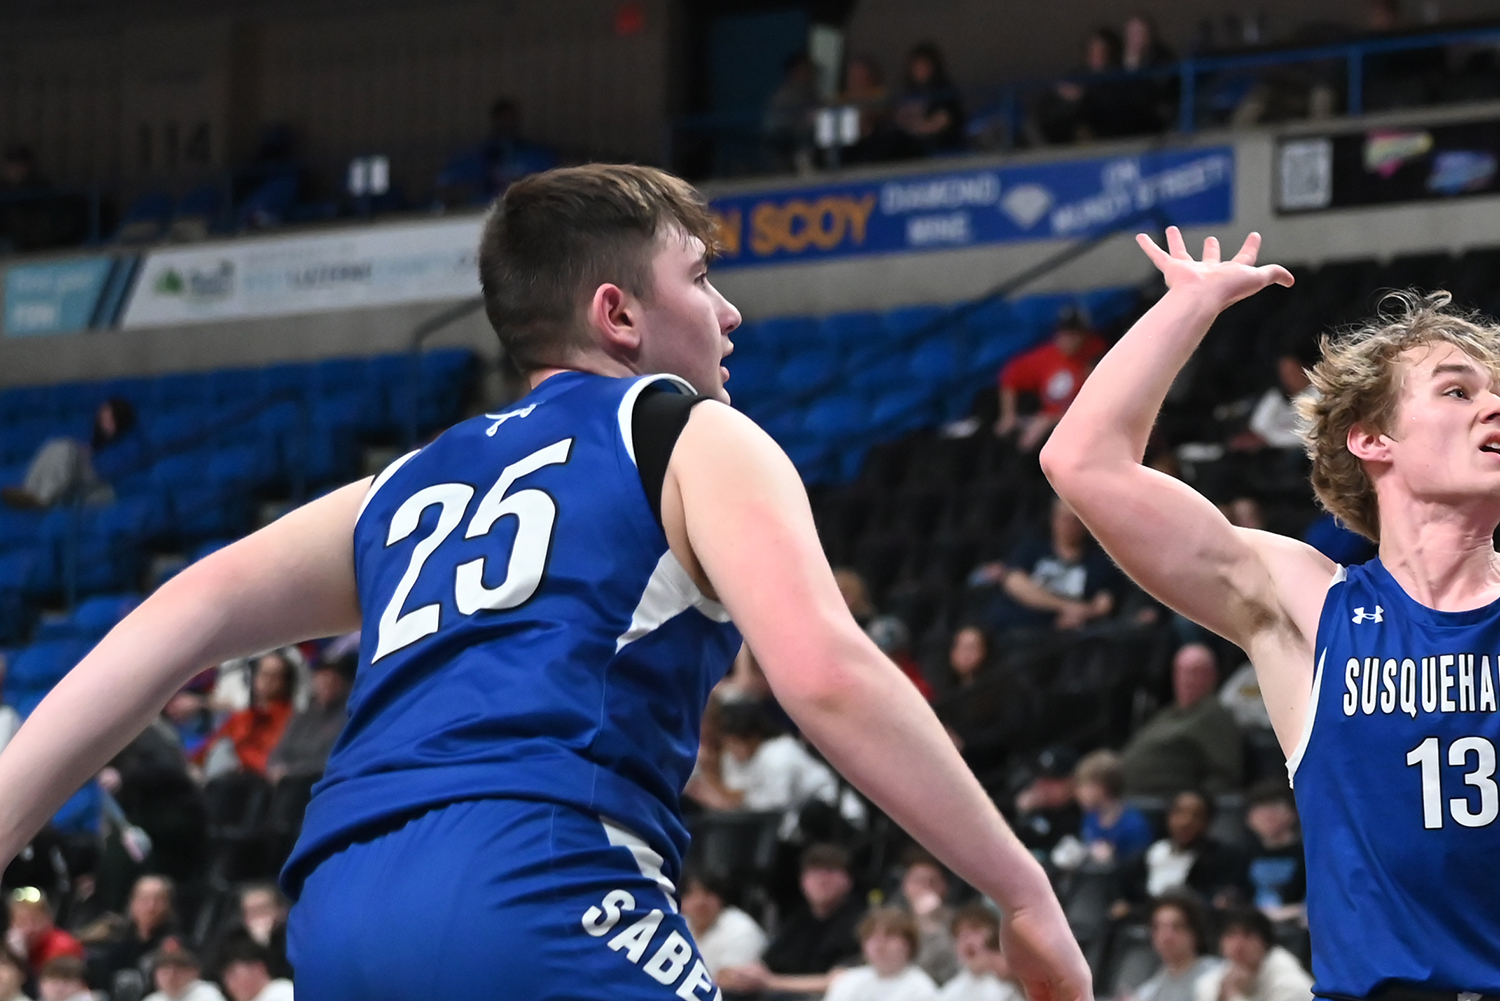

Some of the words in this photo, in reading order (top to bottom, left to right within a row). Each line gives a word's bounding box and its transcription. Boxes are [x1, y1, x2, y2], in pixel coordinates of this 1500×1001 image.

[750, 194, 875, 254] SCOY
[371, 437, 573, 666] 25
[1405, 735, 1500, 830] 13
